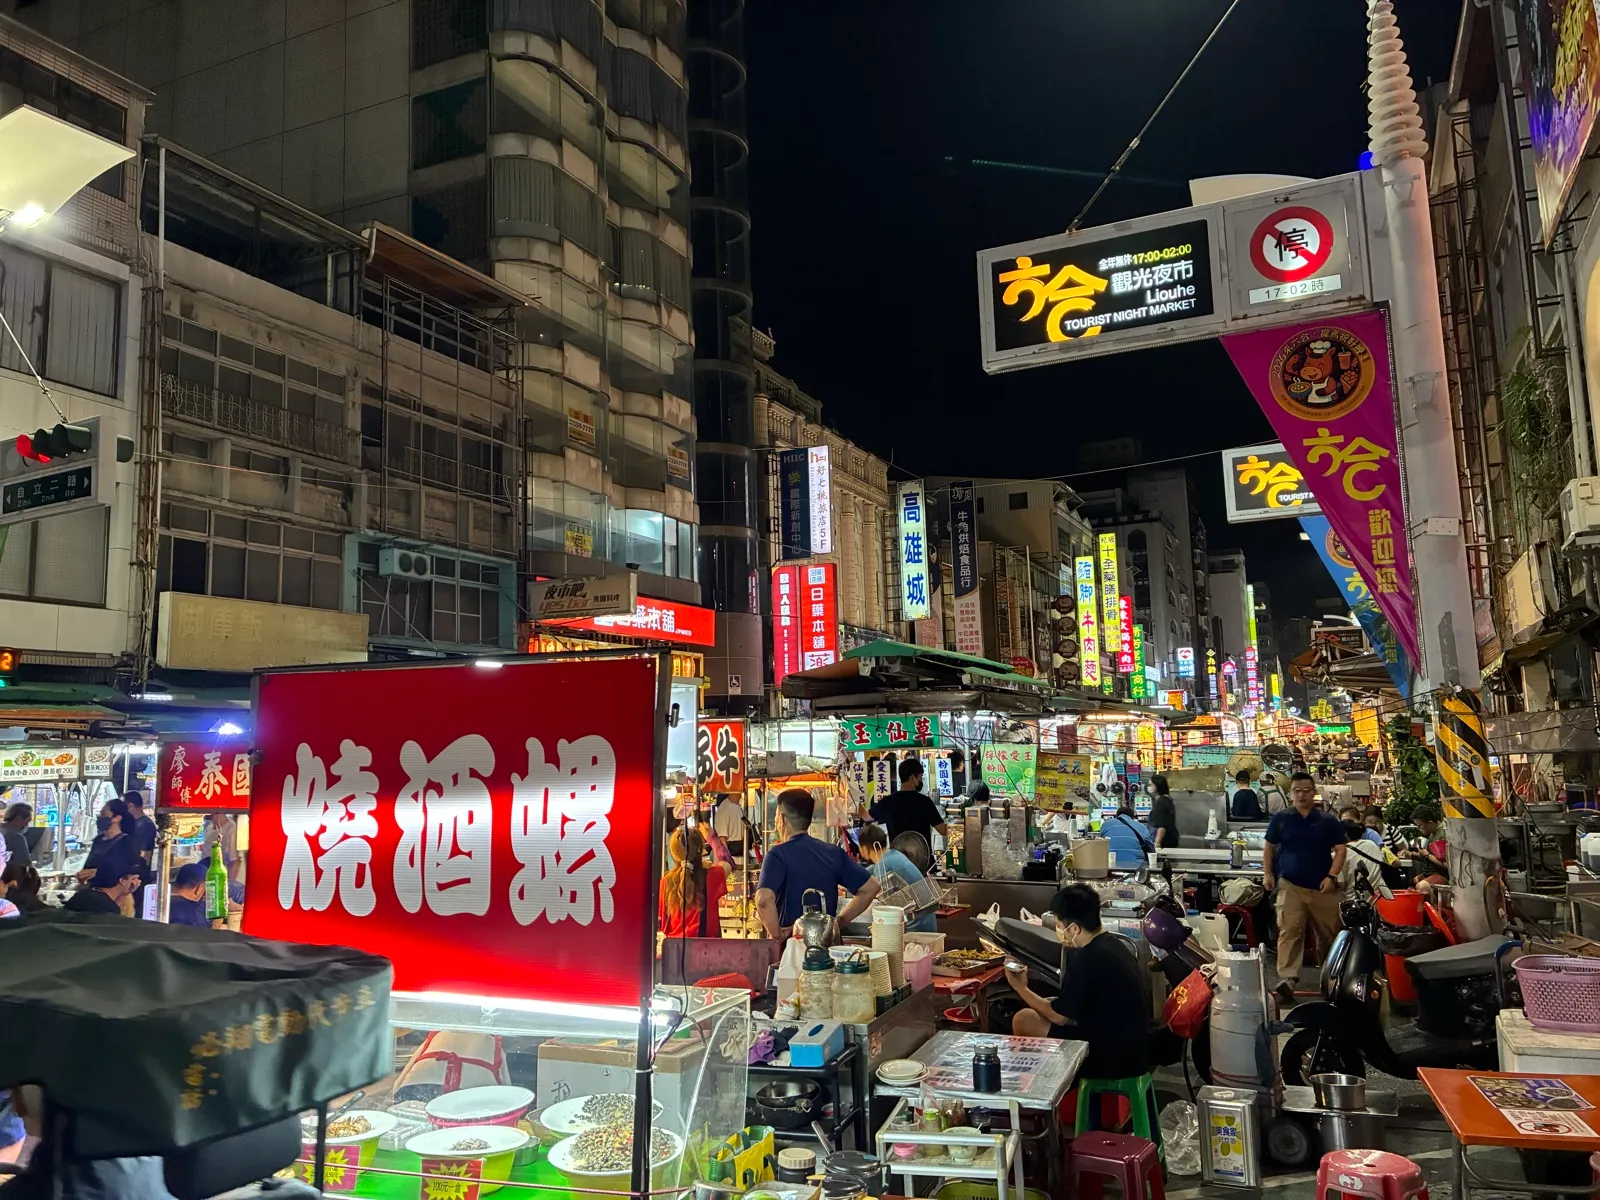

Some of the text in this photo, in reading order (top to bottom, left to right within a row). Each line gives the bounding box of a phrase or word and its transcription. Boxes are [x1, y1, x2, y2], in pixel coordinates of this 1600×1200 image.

[1274, 228, 1309, 262] 停
[1111, 260, 1194, 295] 觀光夜市
[1146, 284, 1196, 304] Liouhe
[1065, 298, 1197, 331] TOURIST NIGHT MARKET
[17, 474, 77, 499] 自立二路
[1278, 491, 1309, 502] TOURIST
[902, 491, 926, 606] 高雄城
[1367, 508, 1400, 594] 歡迎您
[1102, 546, 1118, 621] 十全藥膳排骨
[811, 587, 825, 649] 日藥本舖
[169, 746, 192, 804] 廖師傅
[194, 750, 250, 800] 泰國
[876, 761, 888, 793] 愛玉冰
[938, 760, 951, 788] 粉圓冰
[988, 777, 1007, 785] QQ
[278, 733, 616, 926] 燒酒螺
